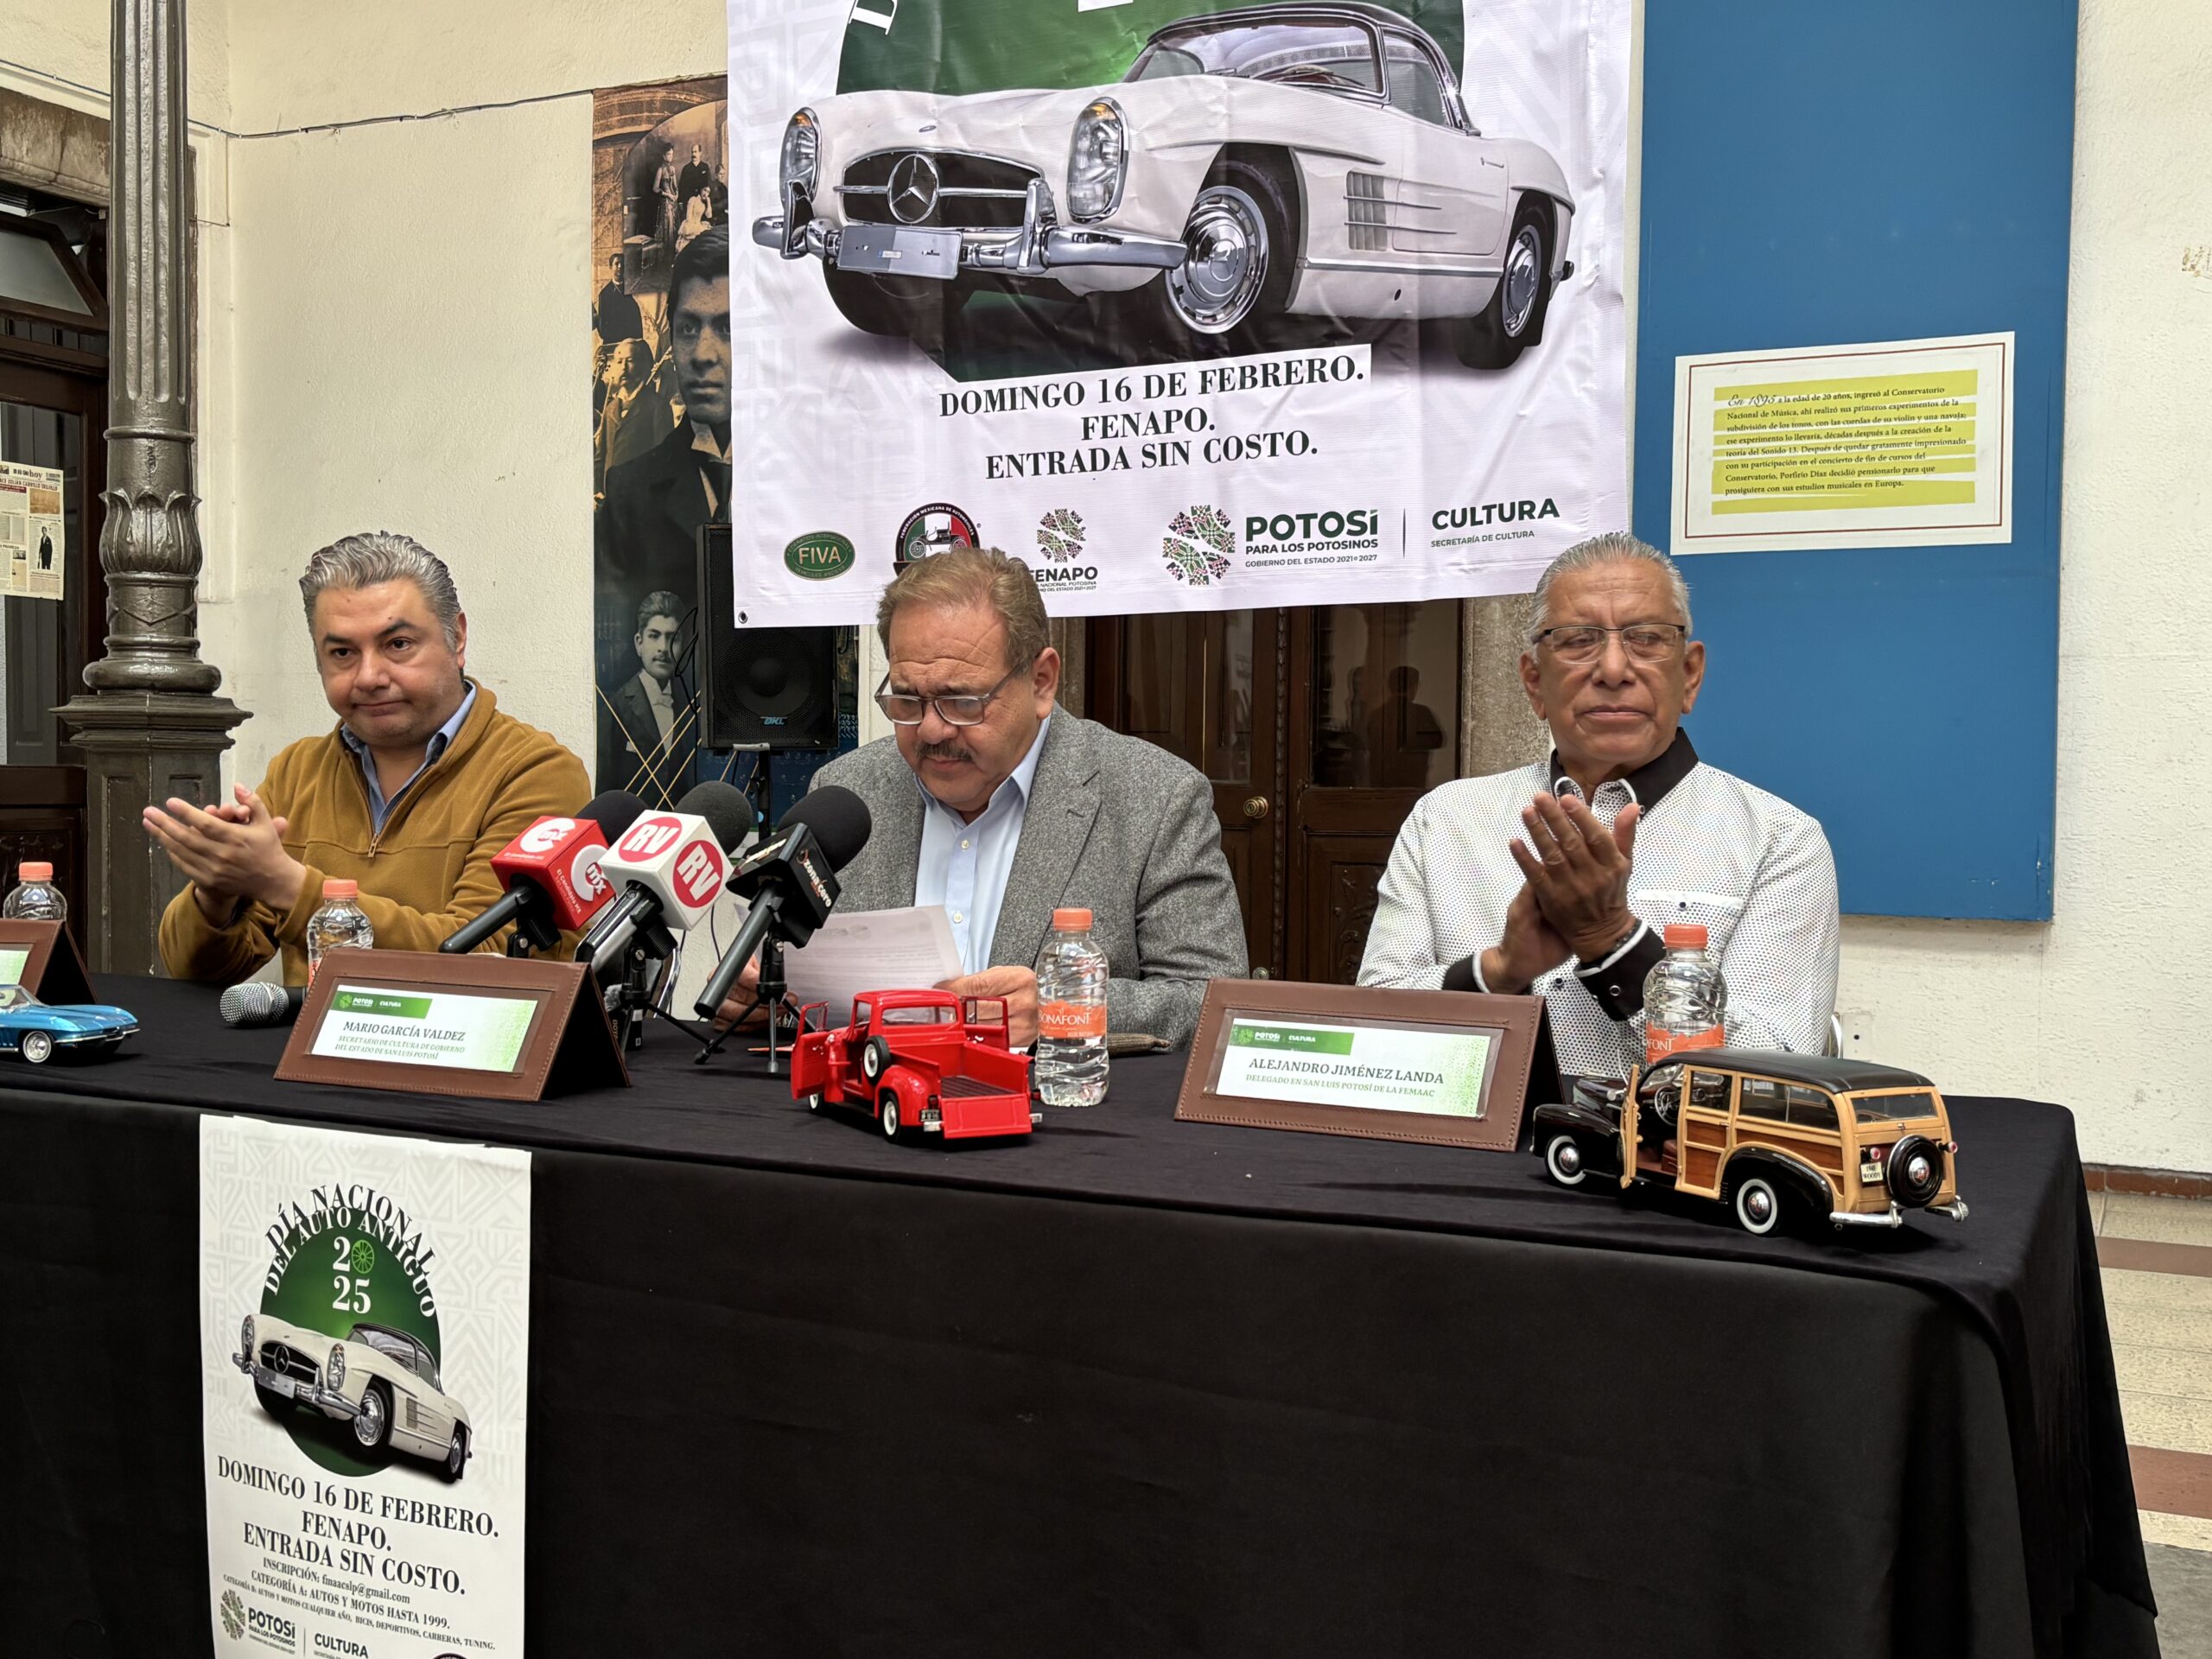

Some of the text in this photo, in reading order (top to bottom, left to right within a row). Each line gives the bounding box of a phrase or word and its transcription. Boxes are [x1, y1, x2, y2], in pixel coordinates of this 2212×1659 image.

[939, 355, 1363, 417] DOMINGO 16 DE FEBRERO.
[1748, 394, 1777, 407] 1895
[1793, 394, 1809, 403] edad
[1854, 391, 1881, 400] ingresó
[1891, 386, 1945, 396] Conservatorio
[1727, 411, 1758, 420] Nacional
[1760, 410, 1770, 418] de
[1853, 404, 1886, 414] primeros
[1888, 401, 1939, 413] experimentos
[1081, 407, 1215, 441] FENAPO.
[1727, 423, 1767, 432] subdivisión
[1739, 435, 1784, 445] experimento
[1854, 429, 1883, 439] después
[1900, 426, 1931, 435] creación
[985, 429, 1318, 479] ENTRADA SIN COSTO.
[1761, 446, 1786, 454] Sonido
[1801, 444, 1831, 454] Después
[1871, 439, 1912, 450] gratamente
[1914, 437, 1967, 448] impresionado
[1726, 473, 1778, 483] Conservatorio,
[1780, 470, 1808, 480] Porfirio
[1828, 467, 1856, 477] decidió
[1857, 466, 1901, 477] pensionarlo
[1903, 464, 1919, 474] para
[1921, 465, 1936, 474] que
[1751, 459, 1797, 470] participación
[1819, 455, 1853, 464] concierto
[1725, 478, 1904, 496] prosiguiera con sus estudios musicales Europa.
[1432, 498, 1560, 531] CULTURA
[1245, 538, 1378, 555] PARA LOS POTOSINOS
[1431, 530, 1535, 549] SECRETARÍA DE CULTURA
[798, 546, 842, 564] FIVA
[1245, 556, 1336, 568] GOBIERNO DEL ESTADO
[623, 823, 677, 855] RV
[677, 843, 720, 902] RV
[804, 858, 832, 907] zona cero
[1038, 1008, 1091, 1025] BONAFONT
[339, 1035, 378, 1046] SECRETARIO
[389, 1040, 419, 1049] CULTURA
[430, 1045, 465, 1053] GOBIERNO
[343, 1021, 466, 1041] MARIO GARCÍA VALDEZ
[348, 1045, 374, 1053] ESTADO
[413, 1051, 439, 1059] POTOSÍ
[1249, 1058, 1444, 1084] ALEJANDRO JIMÉNEZ LANDA
[1246, 1074, 1289, 1085] DELEGADO
[1303, 1078, 1320, 1087] SAN
[1321, 1080, 1339, 1089] LUIS
[1341, 1082, 1372, 1092] POTOSÍ
[1374, 1084, 1385, 1093] DE
[1398, 1087, 1435, 1097] FEMAAC
[264, 1183, 435, 1275] DÍA NACIONAL
[264, 1205, 436, 1318] DEL AUTO ANTIGUO
[333, 1274, 372, 1314] 25
[218, 1455, 499, 1538] DOMINGO 16 DE FEBRERO.
[302, 1510, 391, 1552] FENAPO.
[243, 1522, 466, 1595] ENTRADA SIN COSTO.
[263, 1557, 320, 1583] INSCRIPCIÓN:
[223, 1574, 251, 1591] CATEGORÍA
[257, 1588, 275, 1599] AUTOS
[281, 1595, 301, 1607] MOTOS
[302, 1601, 336, 1617] CUALQUIER
[355, 1616, 374, 1628] BICIS,
[376, 1621, 422, 1637] DEPORTIVOS,
[423, 1630, 462, 1645] CARRERAS,
[463, 1638, 496, 1650] TUNING.
[251, 1569, 450, 1629] CATEGORÍA A: AUTOS Y MOTOS HASTA 1999.
[315, 1633, 369, 1659] CULTURA
